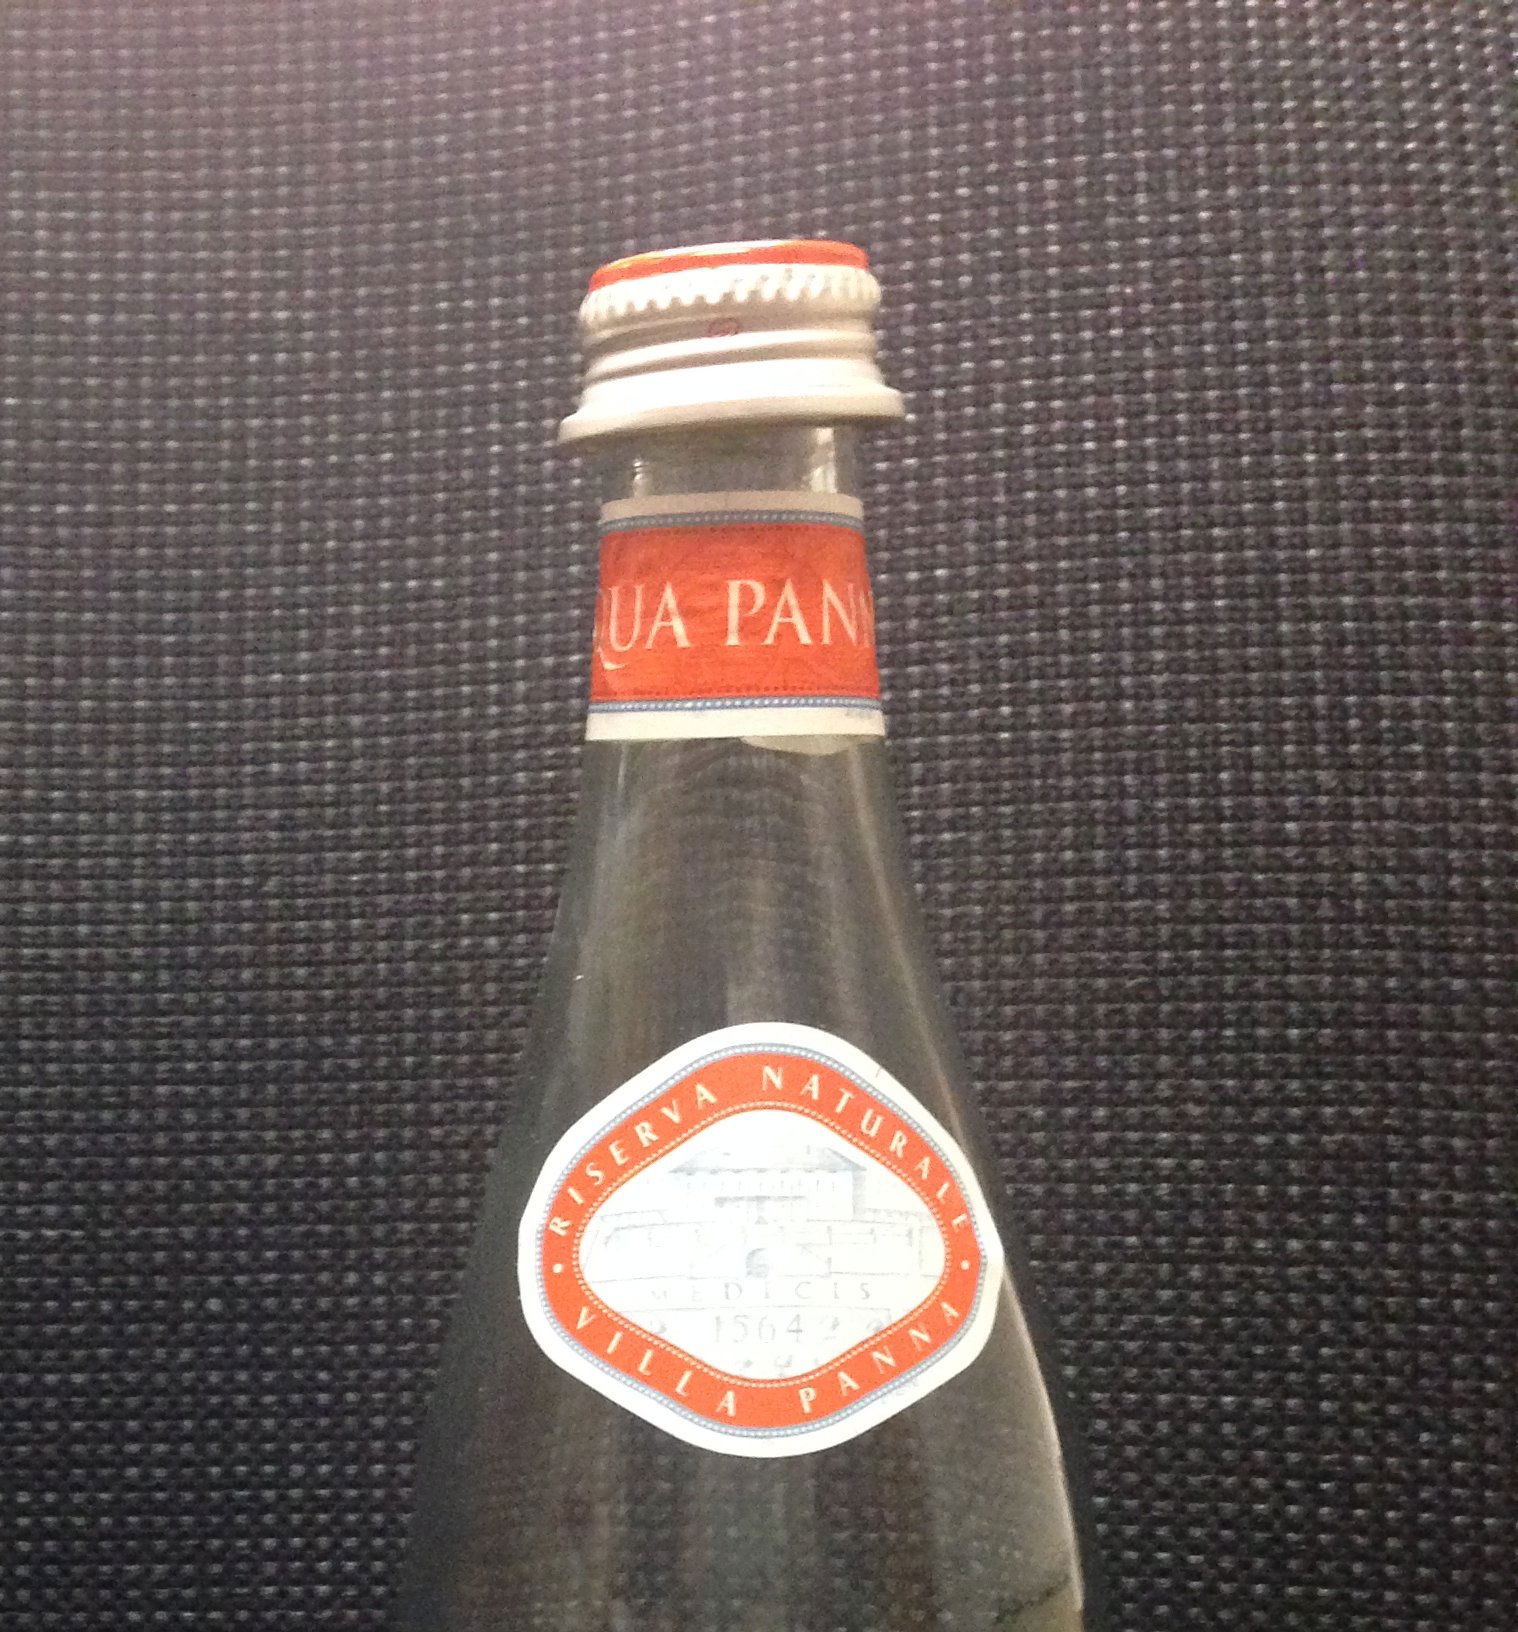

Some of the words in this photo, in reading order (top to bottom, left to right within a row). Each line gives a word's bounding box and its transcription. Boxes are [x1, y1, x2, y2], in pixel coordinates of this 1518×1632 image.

[549, 1082, 718, 1236] RISERVA
[761, 1065, 970, 1233] NATURALE
[576, 1306, 737, 1417] VILLA
[799, 1301, 959, 1414] PANNA
